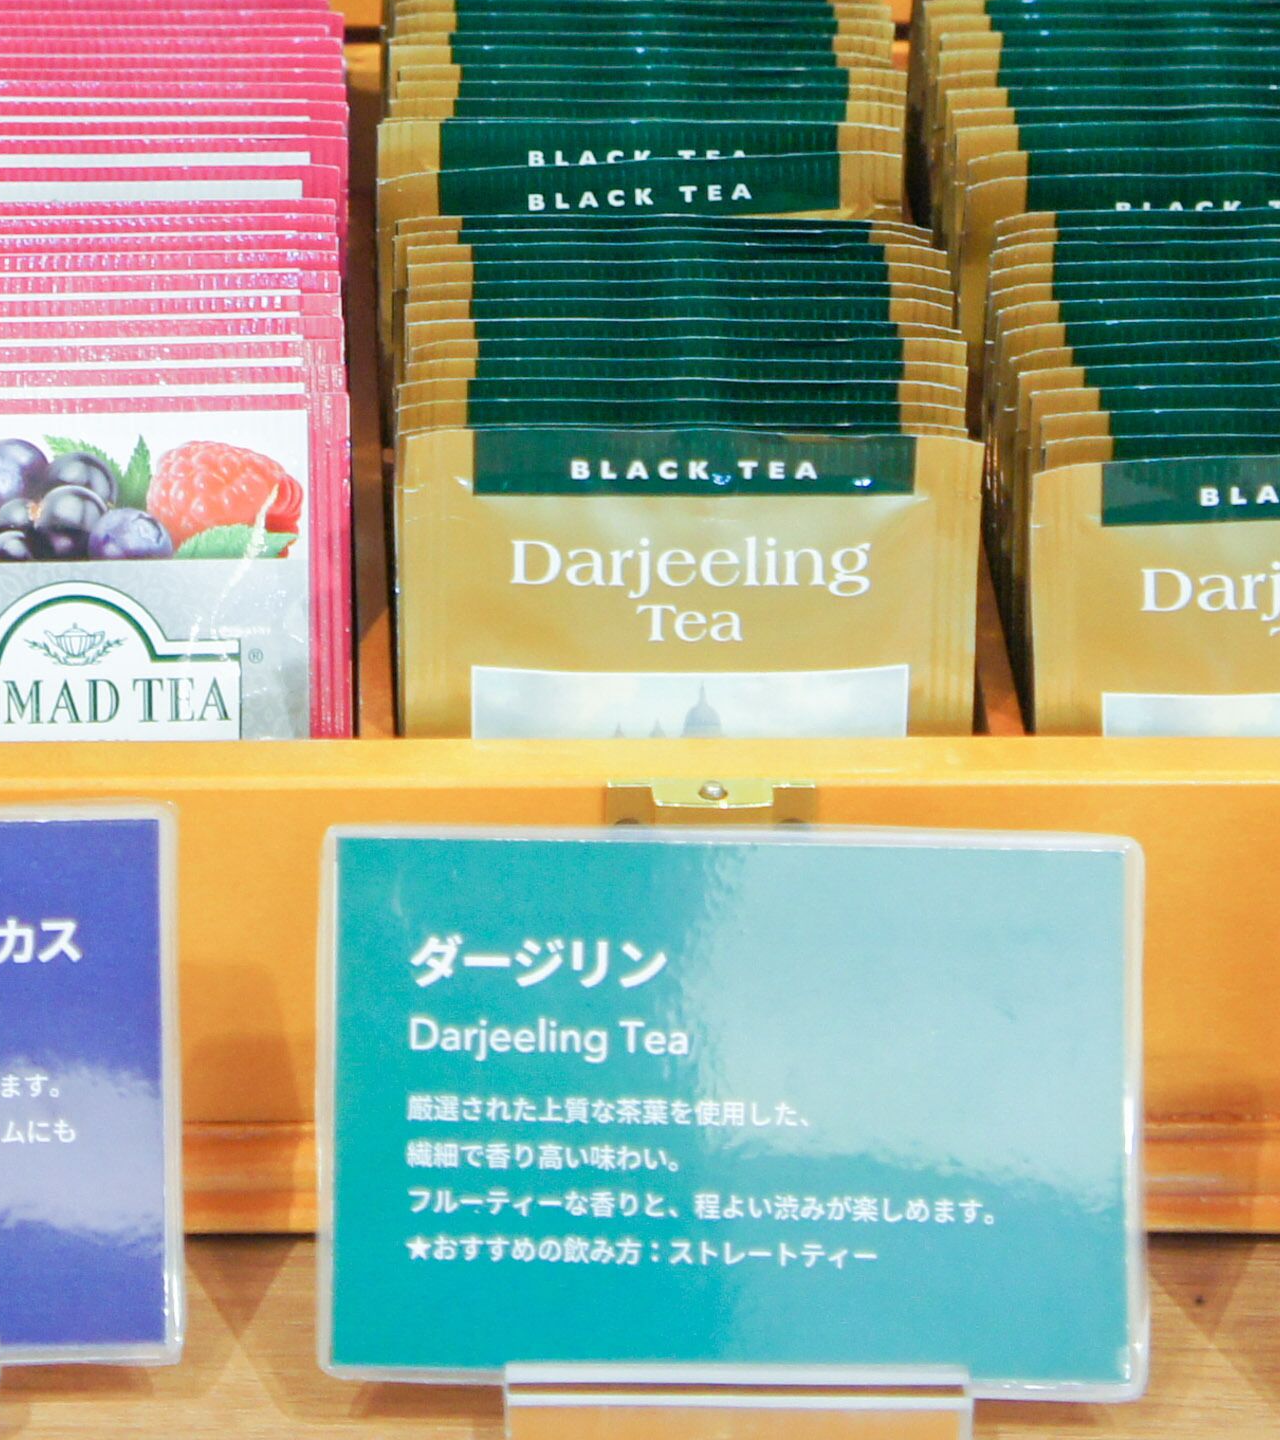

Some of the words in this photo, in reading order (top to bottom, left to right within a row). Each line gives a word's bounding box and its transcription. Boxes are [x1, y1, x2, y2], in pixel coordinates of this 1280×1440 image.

[527, 150, 652, 167] BLACK
[527, 188, 654, 212] BLACK
[678, 183, 753, 204] TEA
[570, 459, 709, 481] BLACK
[737, 459, 819, 481] TEA
[509, 536, 872, 599] Darjeeling
[636, 603, 744, 643] Tea
[132, 676, 233, 723] TEA
[408, 934, 669, 991] ダージリン
[408, 1016, 609, 1063] Darjeeling
[619, 1020, 690, 1057] Tea
[405, 1095, 811, 1128] 厳選された上質な茶葉を使用した、
[405, 1140, 680, 1173] 繊細で香り高い味わい。
[407, 1189, 996, 1226] フルーティーな香りと、程よい渋みが楽しめます。
